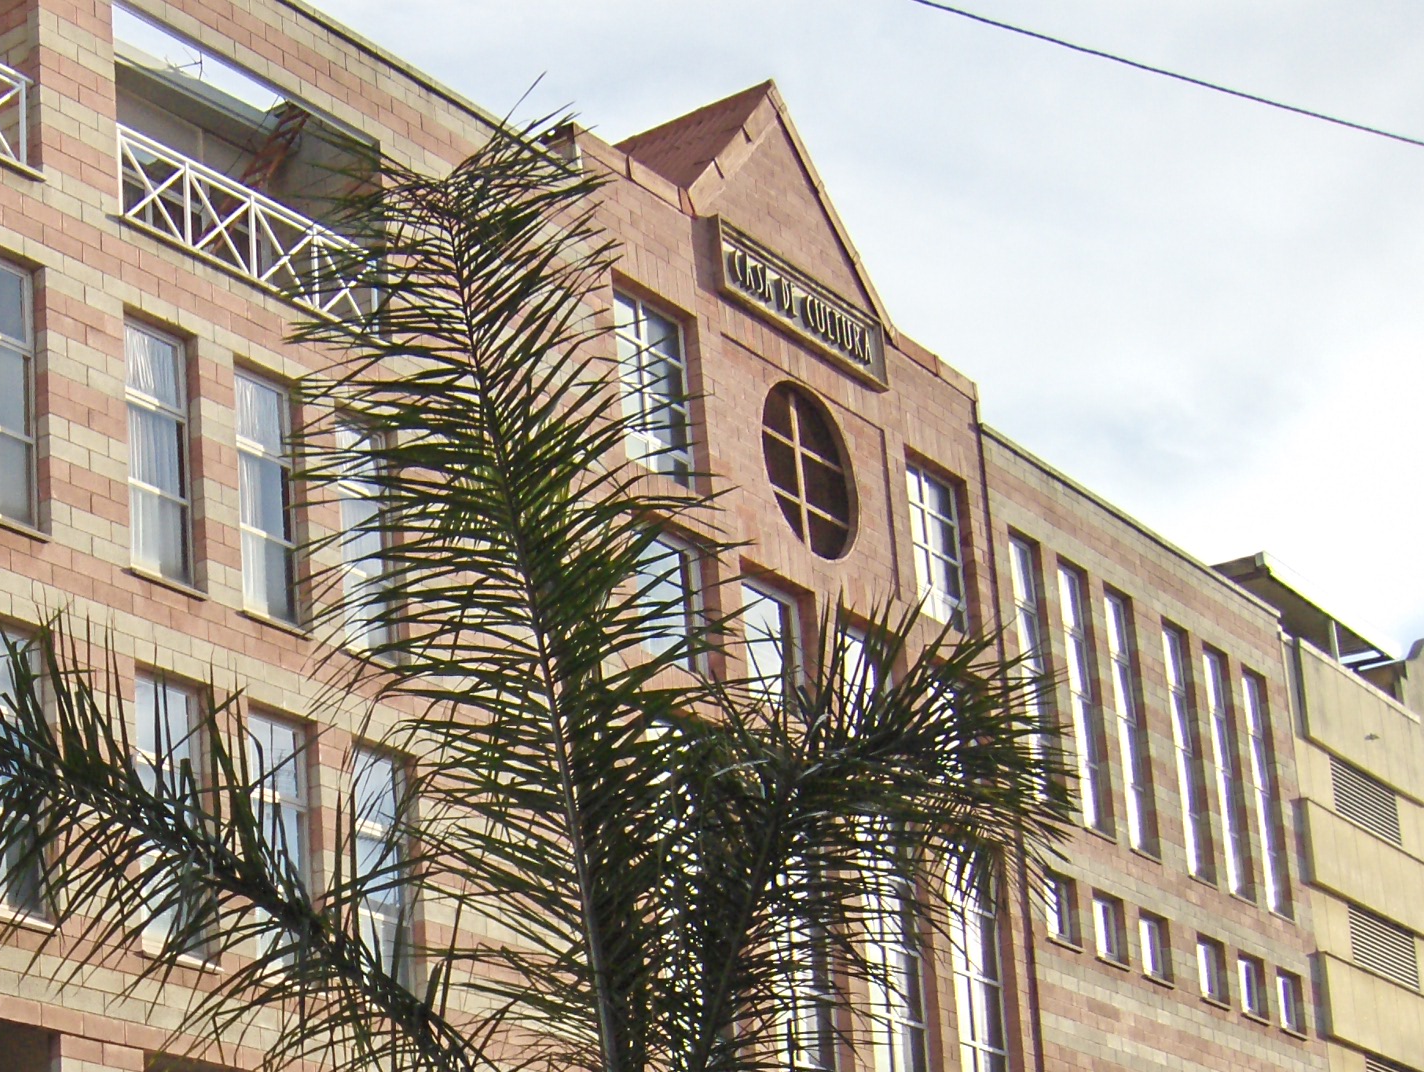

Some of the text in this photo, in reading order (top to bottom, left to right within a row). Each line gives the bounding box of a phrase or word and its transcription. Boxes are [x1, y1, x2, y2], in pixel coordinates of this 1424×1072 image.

[733, 248, 873, 364] CASA DE CULTURA
